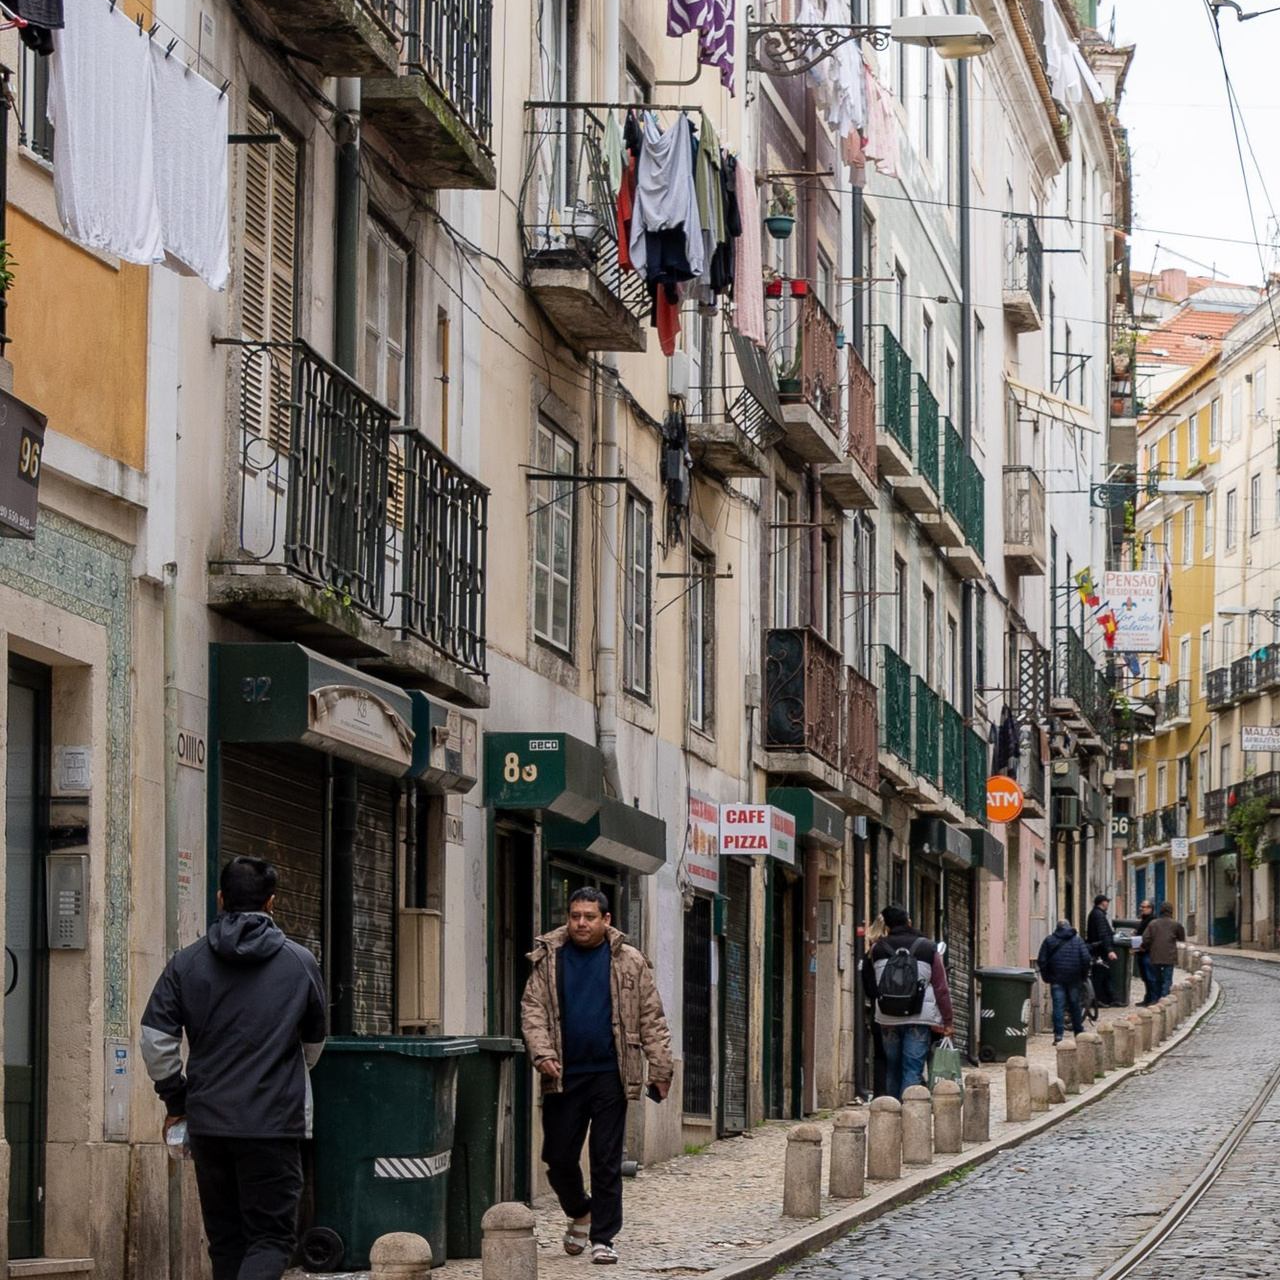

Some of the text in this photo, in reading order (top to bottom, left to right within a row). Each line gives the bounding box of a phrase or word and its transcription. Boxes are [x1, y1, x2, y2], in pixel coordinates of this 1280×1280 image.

[20, 436, 40, 479] 96
[1244, 727, 1280, 737] MALAS
[986, 791, 1018, 807] ATM
[726, 809, 765, 823] CAFE
[724, 835, 768, 849] PIZZA
